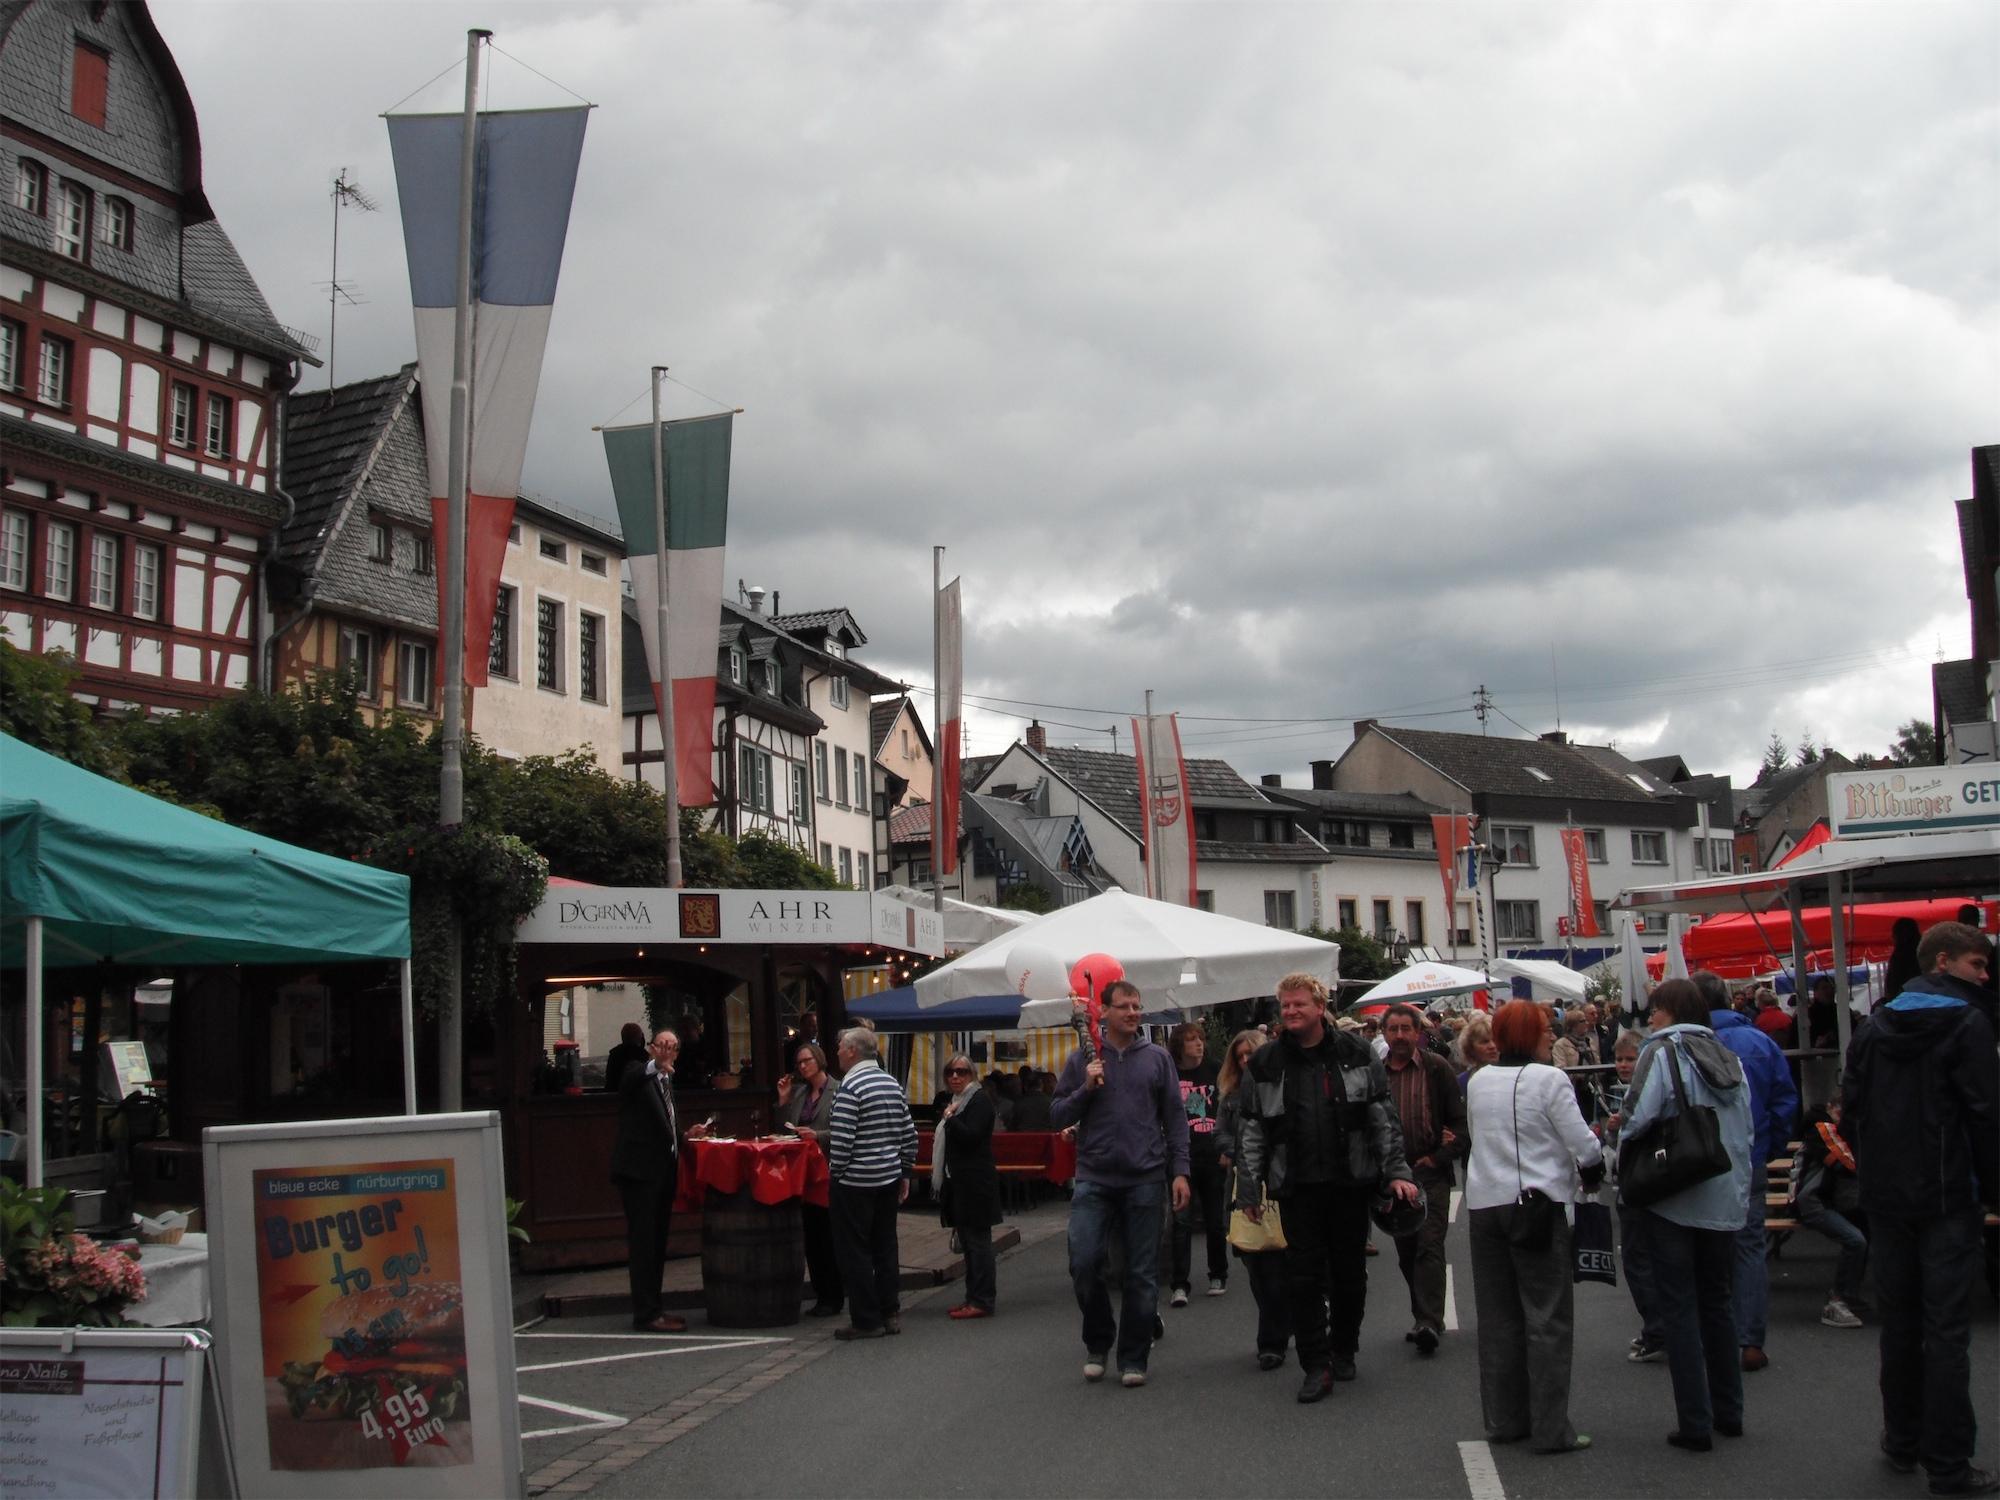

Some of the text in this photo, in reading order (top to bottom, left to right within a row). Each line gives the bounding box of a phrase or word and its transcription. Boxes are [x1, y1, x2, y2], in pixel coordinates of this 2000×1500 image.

[1845, 781, 1953, 821] Bitburger
[748, 901, 833, 919] AHR
[748, 923, 833, 933] WINZER
[269, 1172, 439, 1194] blaue ecke nürburgring
[264, 1198, 403, 1260] Burger
[329, 1224, 431, 1297] to go!
[23, 1363, 69, 1379] Nails
[81, 1394, 155, 1416] Nagelstudio
[360, 1384, 430, 1440] 4,95
[104, 1413, 129, 1426] und
[83, 1428, 144, 1446] Fußpflege
[403, 1417, 445, 1448] Euro
